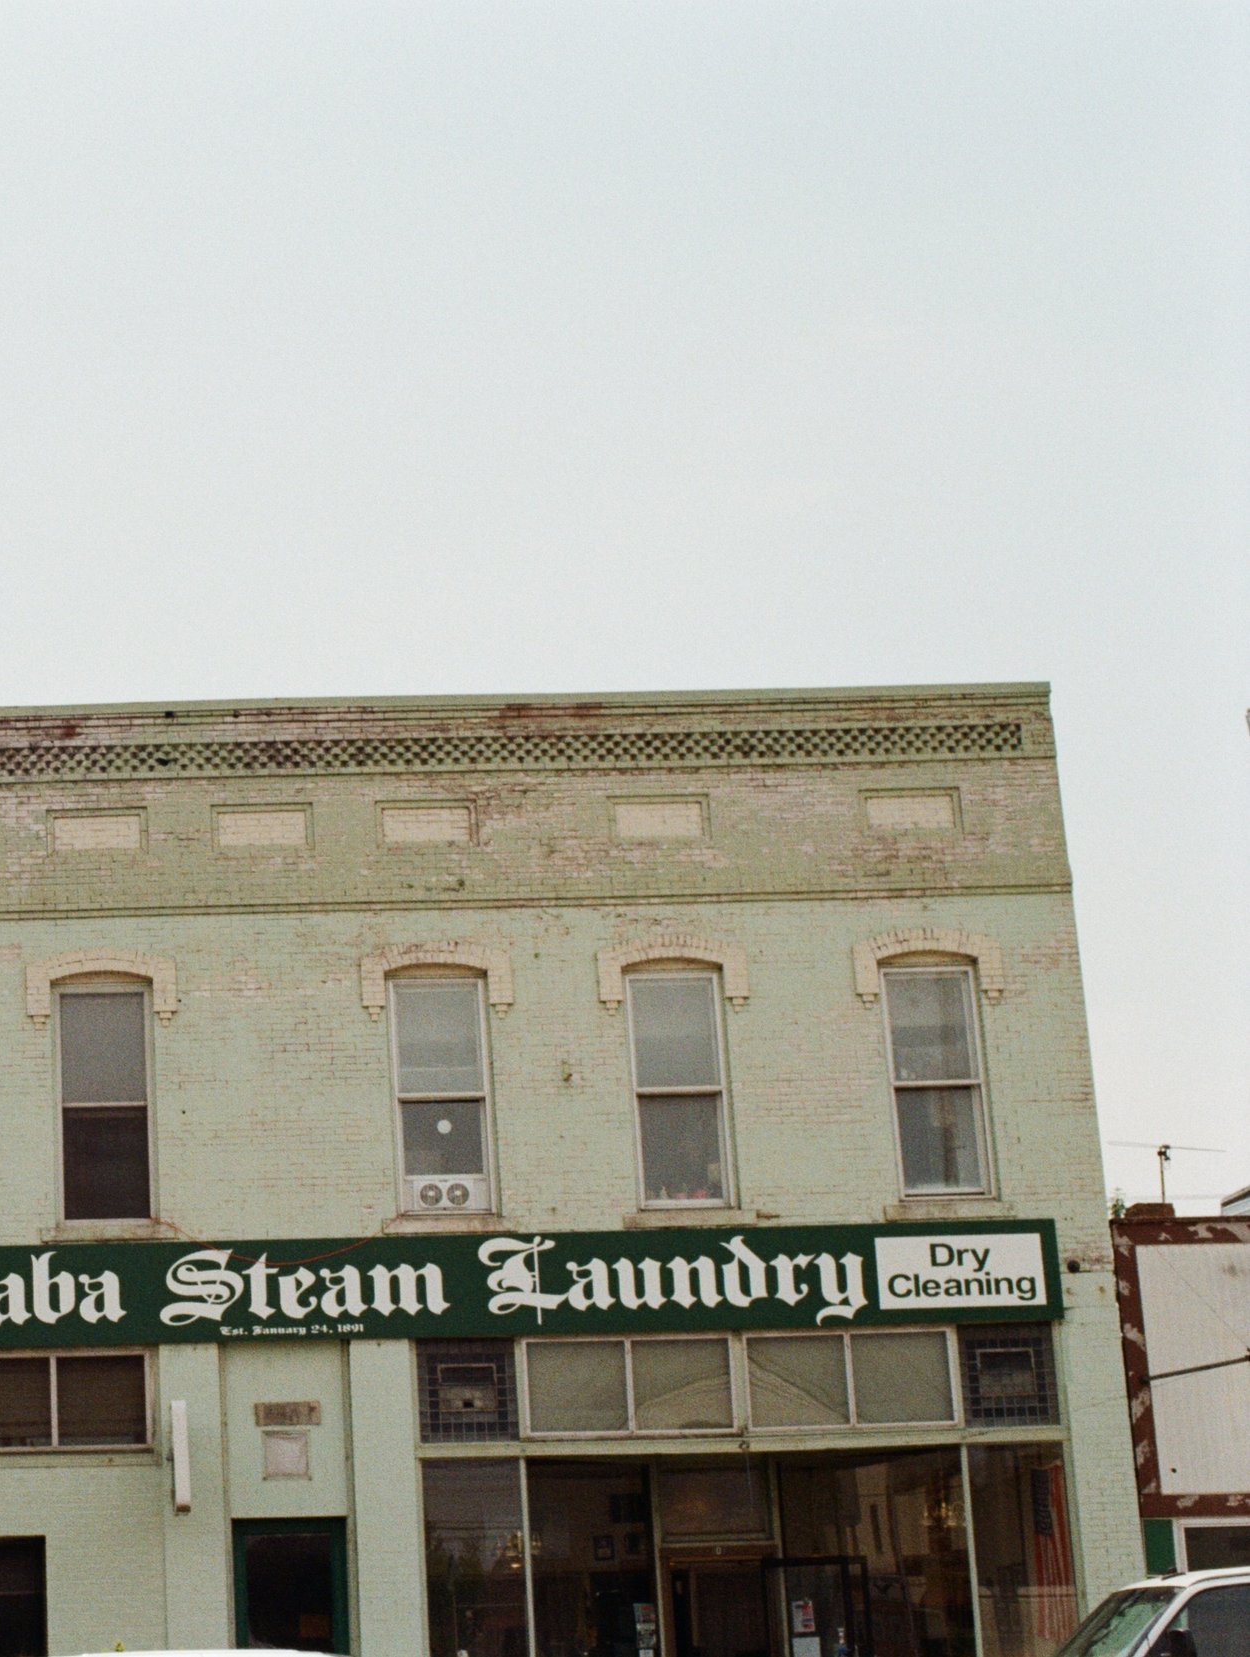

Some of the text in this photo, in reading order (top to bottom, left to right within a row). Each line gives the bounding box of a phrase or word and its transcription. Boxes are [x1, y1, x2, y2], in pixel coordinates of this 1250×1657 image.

[929, 1243, 990, 1273] Dry
[158, 1248, 451, 1326] Steam
[477, 1235, 869, 1327] Laundry
[887, 1272, 1037, 1301] Cleaning
[219, 1326, 249, 1336] Est.
[252, 1325, 307, 1336] January
[337, 1323, 364, 1333] 1891
